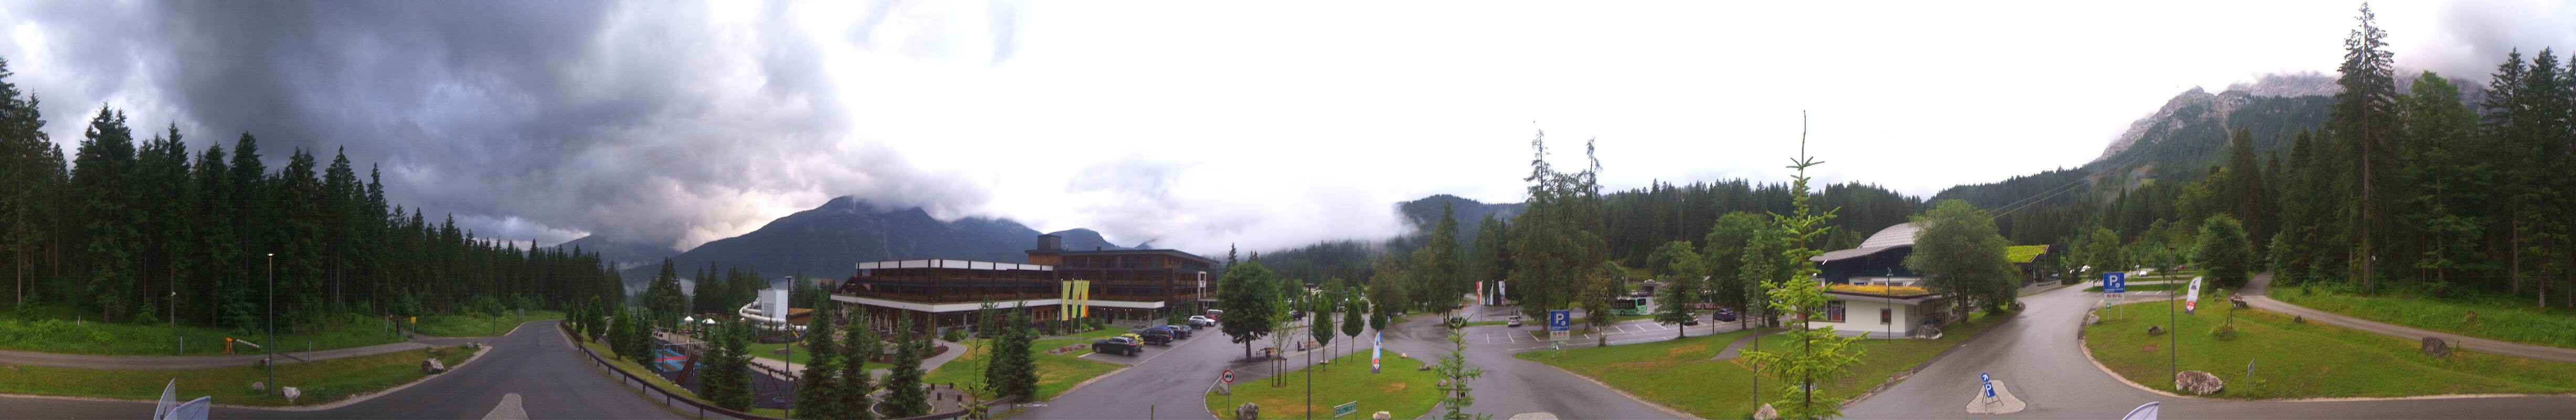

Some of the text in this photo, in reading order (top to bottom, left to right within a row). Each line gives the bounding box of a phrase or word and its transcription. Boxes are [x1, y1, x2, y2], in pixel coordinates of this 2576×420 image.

[2109, 275, 2118, 286] P
[1556, 313, 1564, 324] P
[1985, 384, 1991, 396] P
